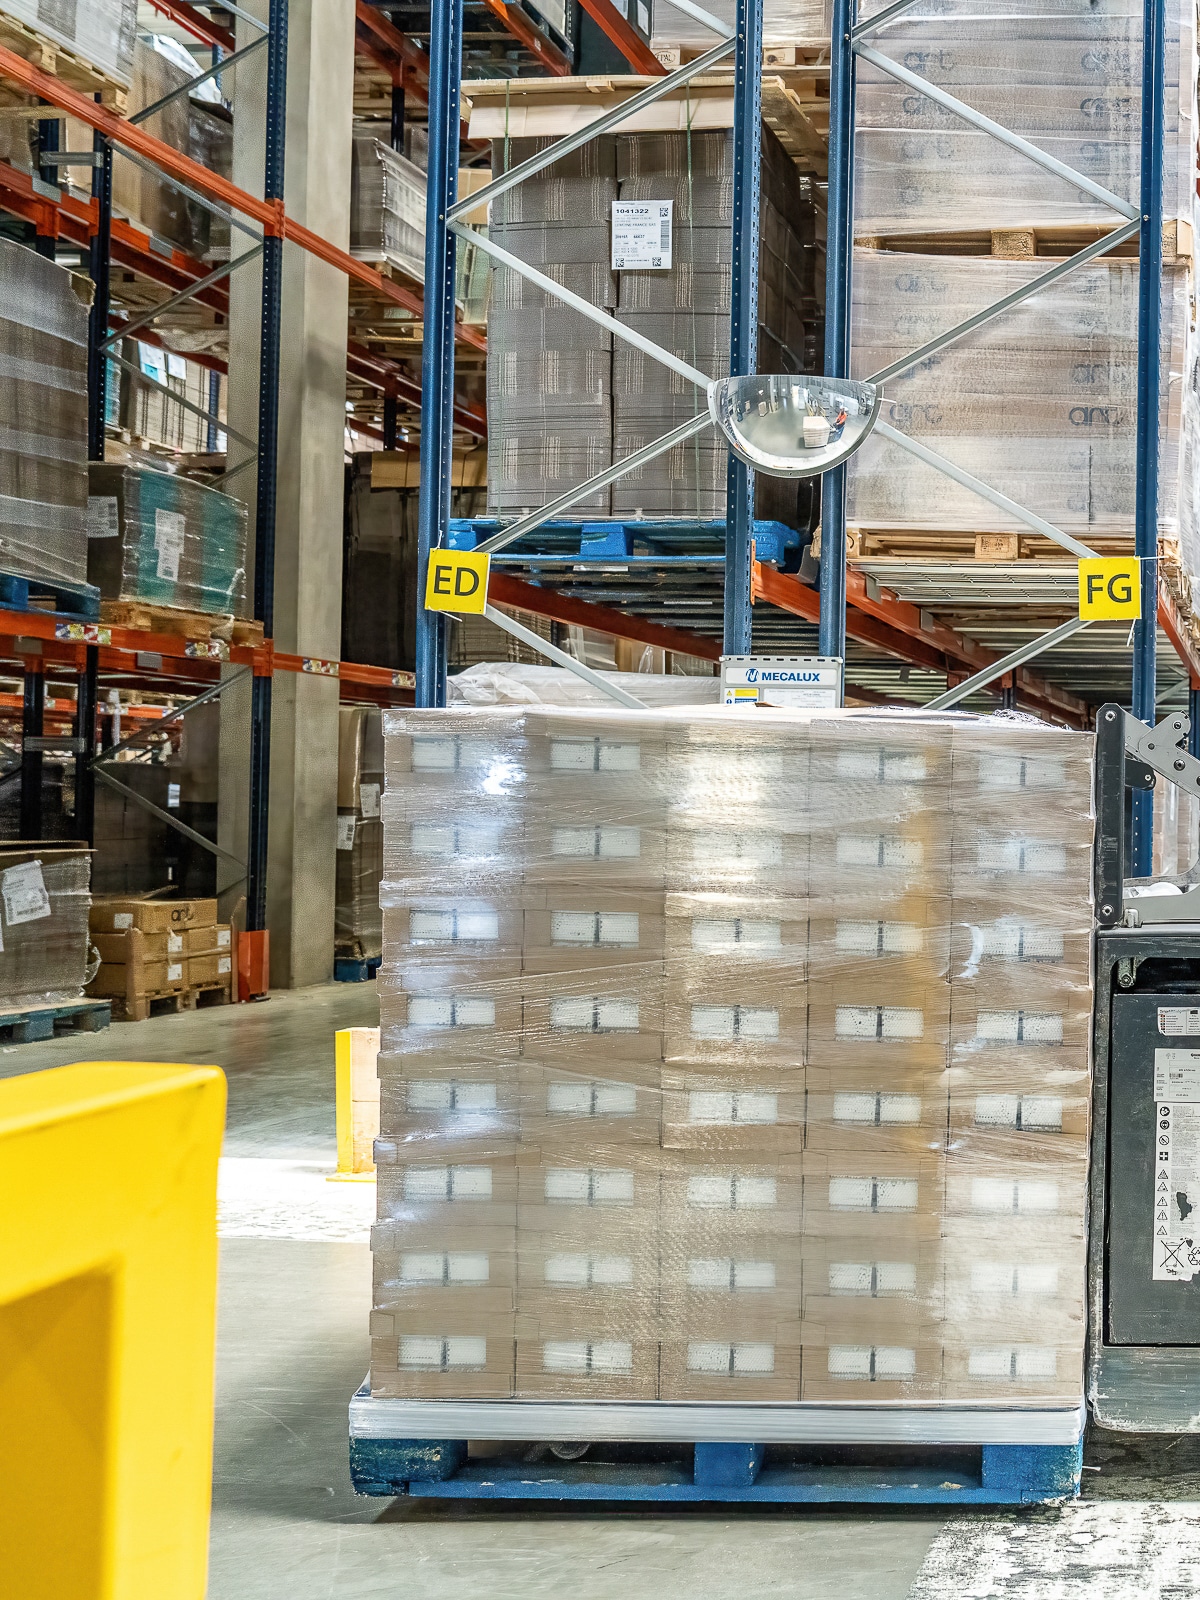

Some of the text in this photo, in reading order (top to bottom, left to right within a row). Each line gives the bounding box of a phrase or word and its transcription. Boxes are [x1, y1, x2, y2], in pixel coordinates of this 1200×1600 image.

[434, 565, 480, 596] ED
[1087, 573, 1132, 604] FG
[761, 672, 820, 681] MECALUX
